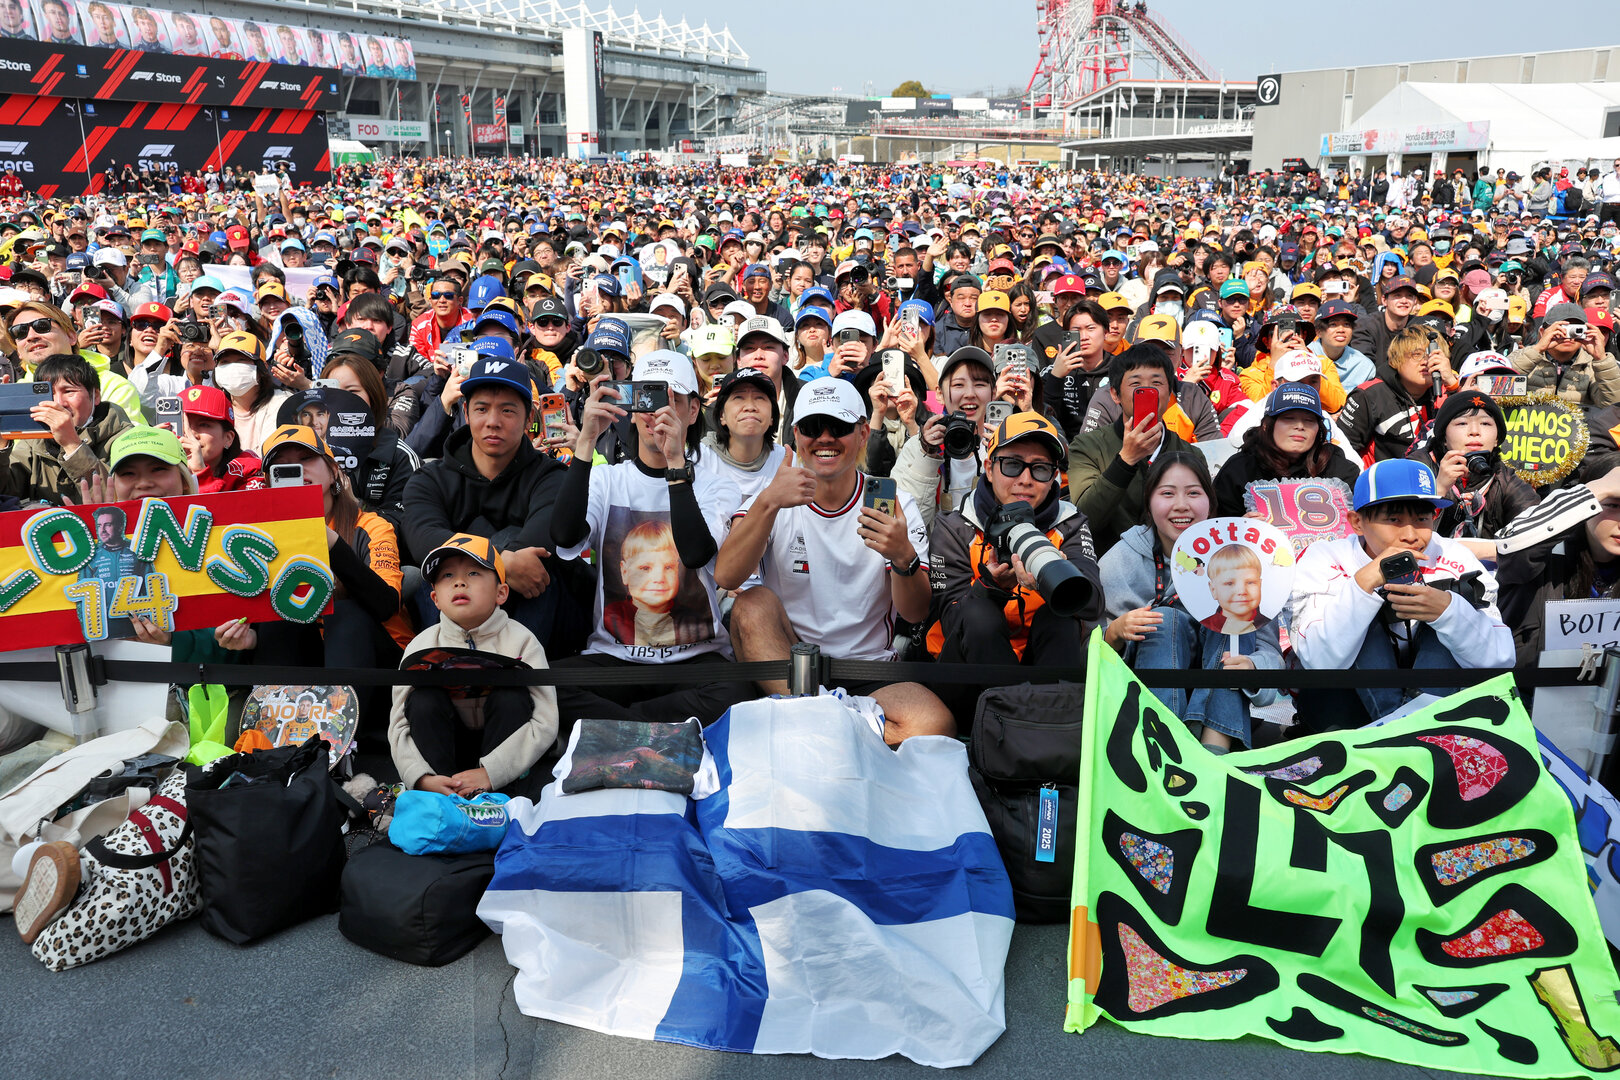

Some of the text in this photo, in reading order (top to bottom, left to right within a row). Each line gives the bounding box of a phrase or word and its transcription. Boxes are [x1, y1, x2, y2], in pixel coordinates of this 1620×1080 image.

[0, 58, 32, 72] Store
[156, 72, 182, 83] Store
[280, 82, 301, 91] Store
[358, 124, 380, 136] FOD
[1405, 133, 1421, 141] Honda
[594, 336, 623, 347] Williams
[484, 361, 510, 374] W
[1290, 358, 1319, 368] Red Bull
[808, 395, 841, 403] CADILLAC
[1283, 393, 1316, 405] Williams
[1505, 408, 1572, 437] VAMOS
[329, 426, 376, 434] CADILLAC
[1503, 434, 1570, 464] CHECO
[1256, 487, 1337, 530] 18
[64, 572, 179, 641] 14
[660, 646, 673, 659] IS
[1040, 826, 1052, 850] 2025
